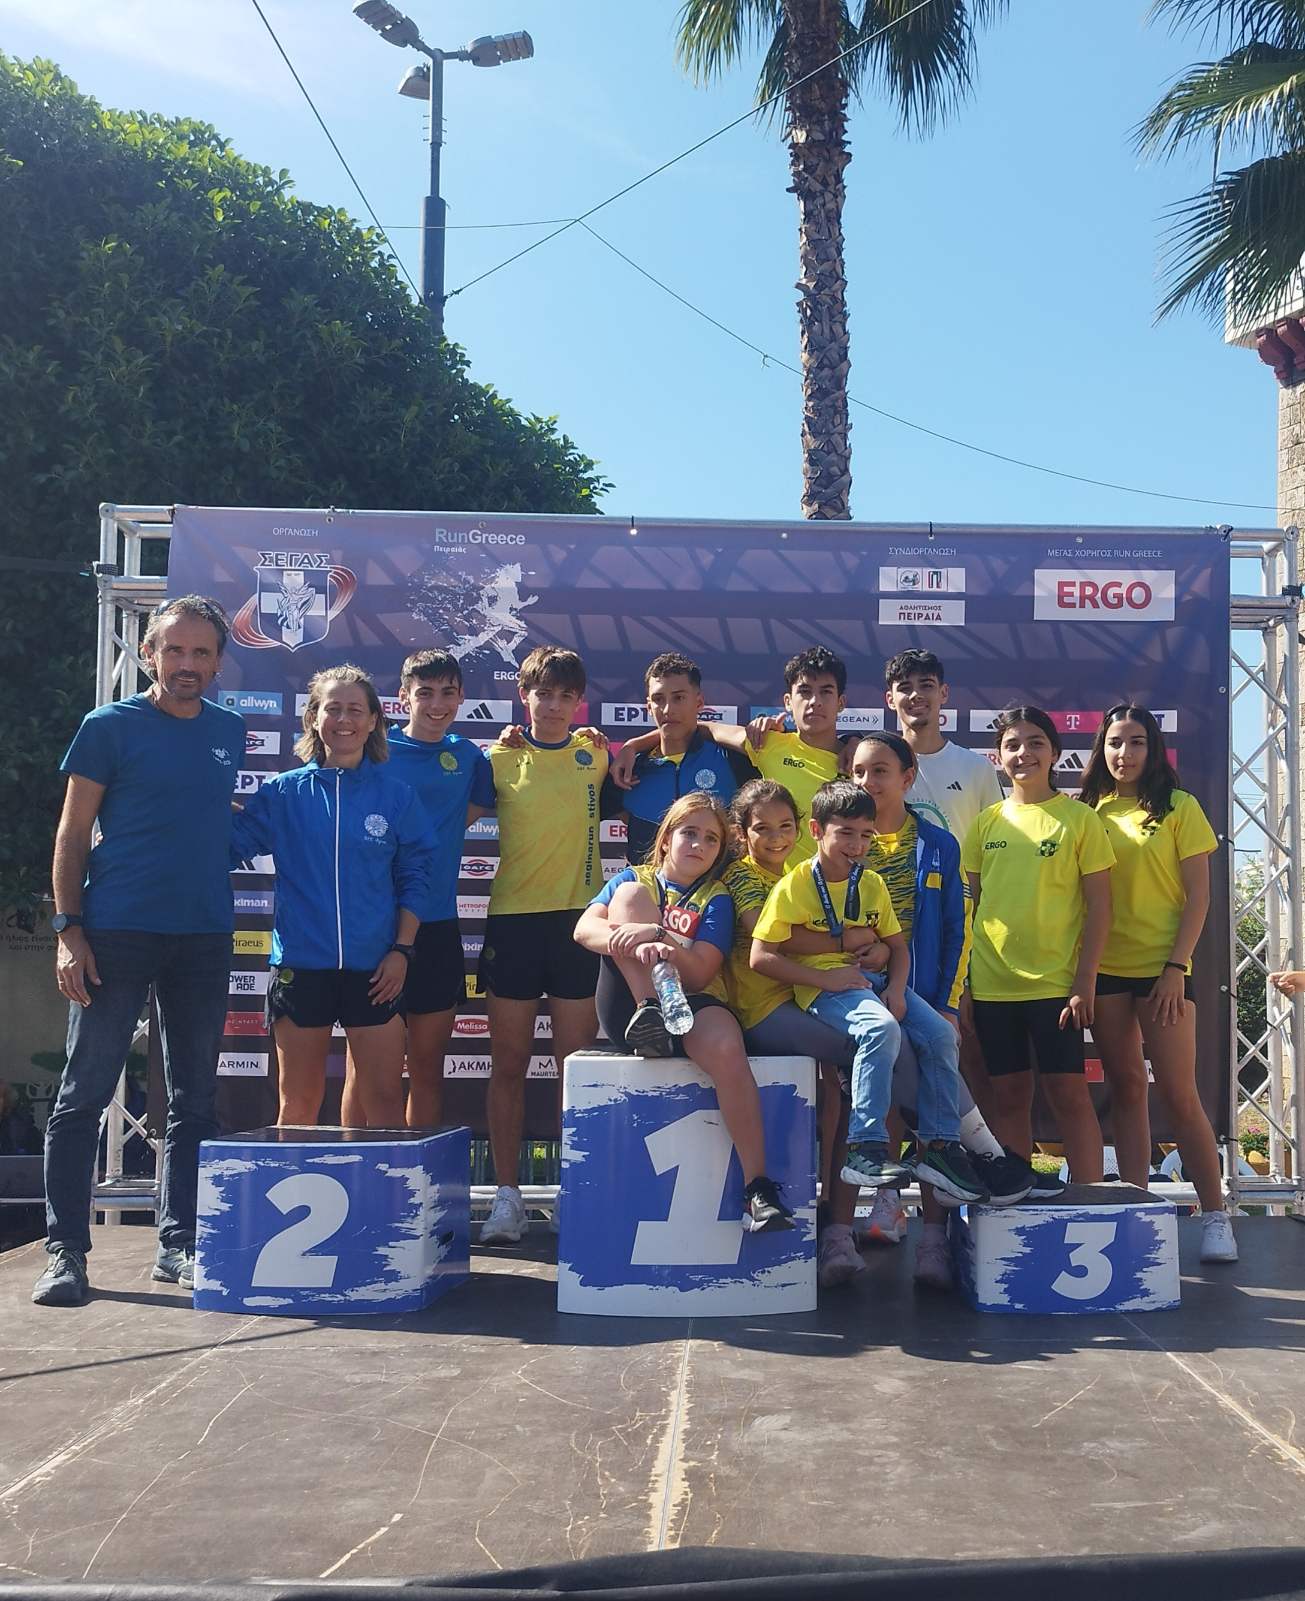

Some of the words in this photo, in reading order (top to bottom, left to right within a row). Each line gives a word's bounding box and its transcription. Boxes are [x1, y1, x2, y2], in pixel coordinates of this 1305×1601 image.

[272, 527, 319, 537] ΟΡΓΑΝΩΣΗ
[435, 527, 526, 545] RunGreece
[888, 546, 957, 556] ΣΥΝΔΙΟΡΓΑΝΩΣΗ
[1047, 549, 1073, 557] ΜΕΓΑΣ
[1132, 550, 1163, 558] GREECE
[258, 551, 330, 568] ΣΕΓΑΣ
[1057, 580, 1153, 610] ERGO
[240, 696, 277, 710] allwyn
[383, 701, 410, 715] ERG
[783, 757, 805, 768] ERGO
[985, 840, 1007, 850] ERGO
[234, 937, 264, 947] iraeus
[229, 975, 255, 983] OWER
[219, 1060, 259, 1070] ARMIN
[630, 1109, 744, 1265] 1
[250, 1173, 350, 1288] 2
[1050, 1221, 1118, 1300] 3
